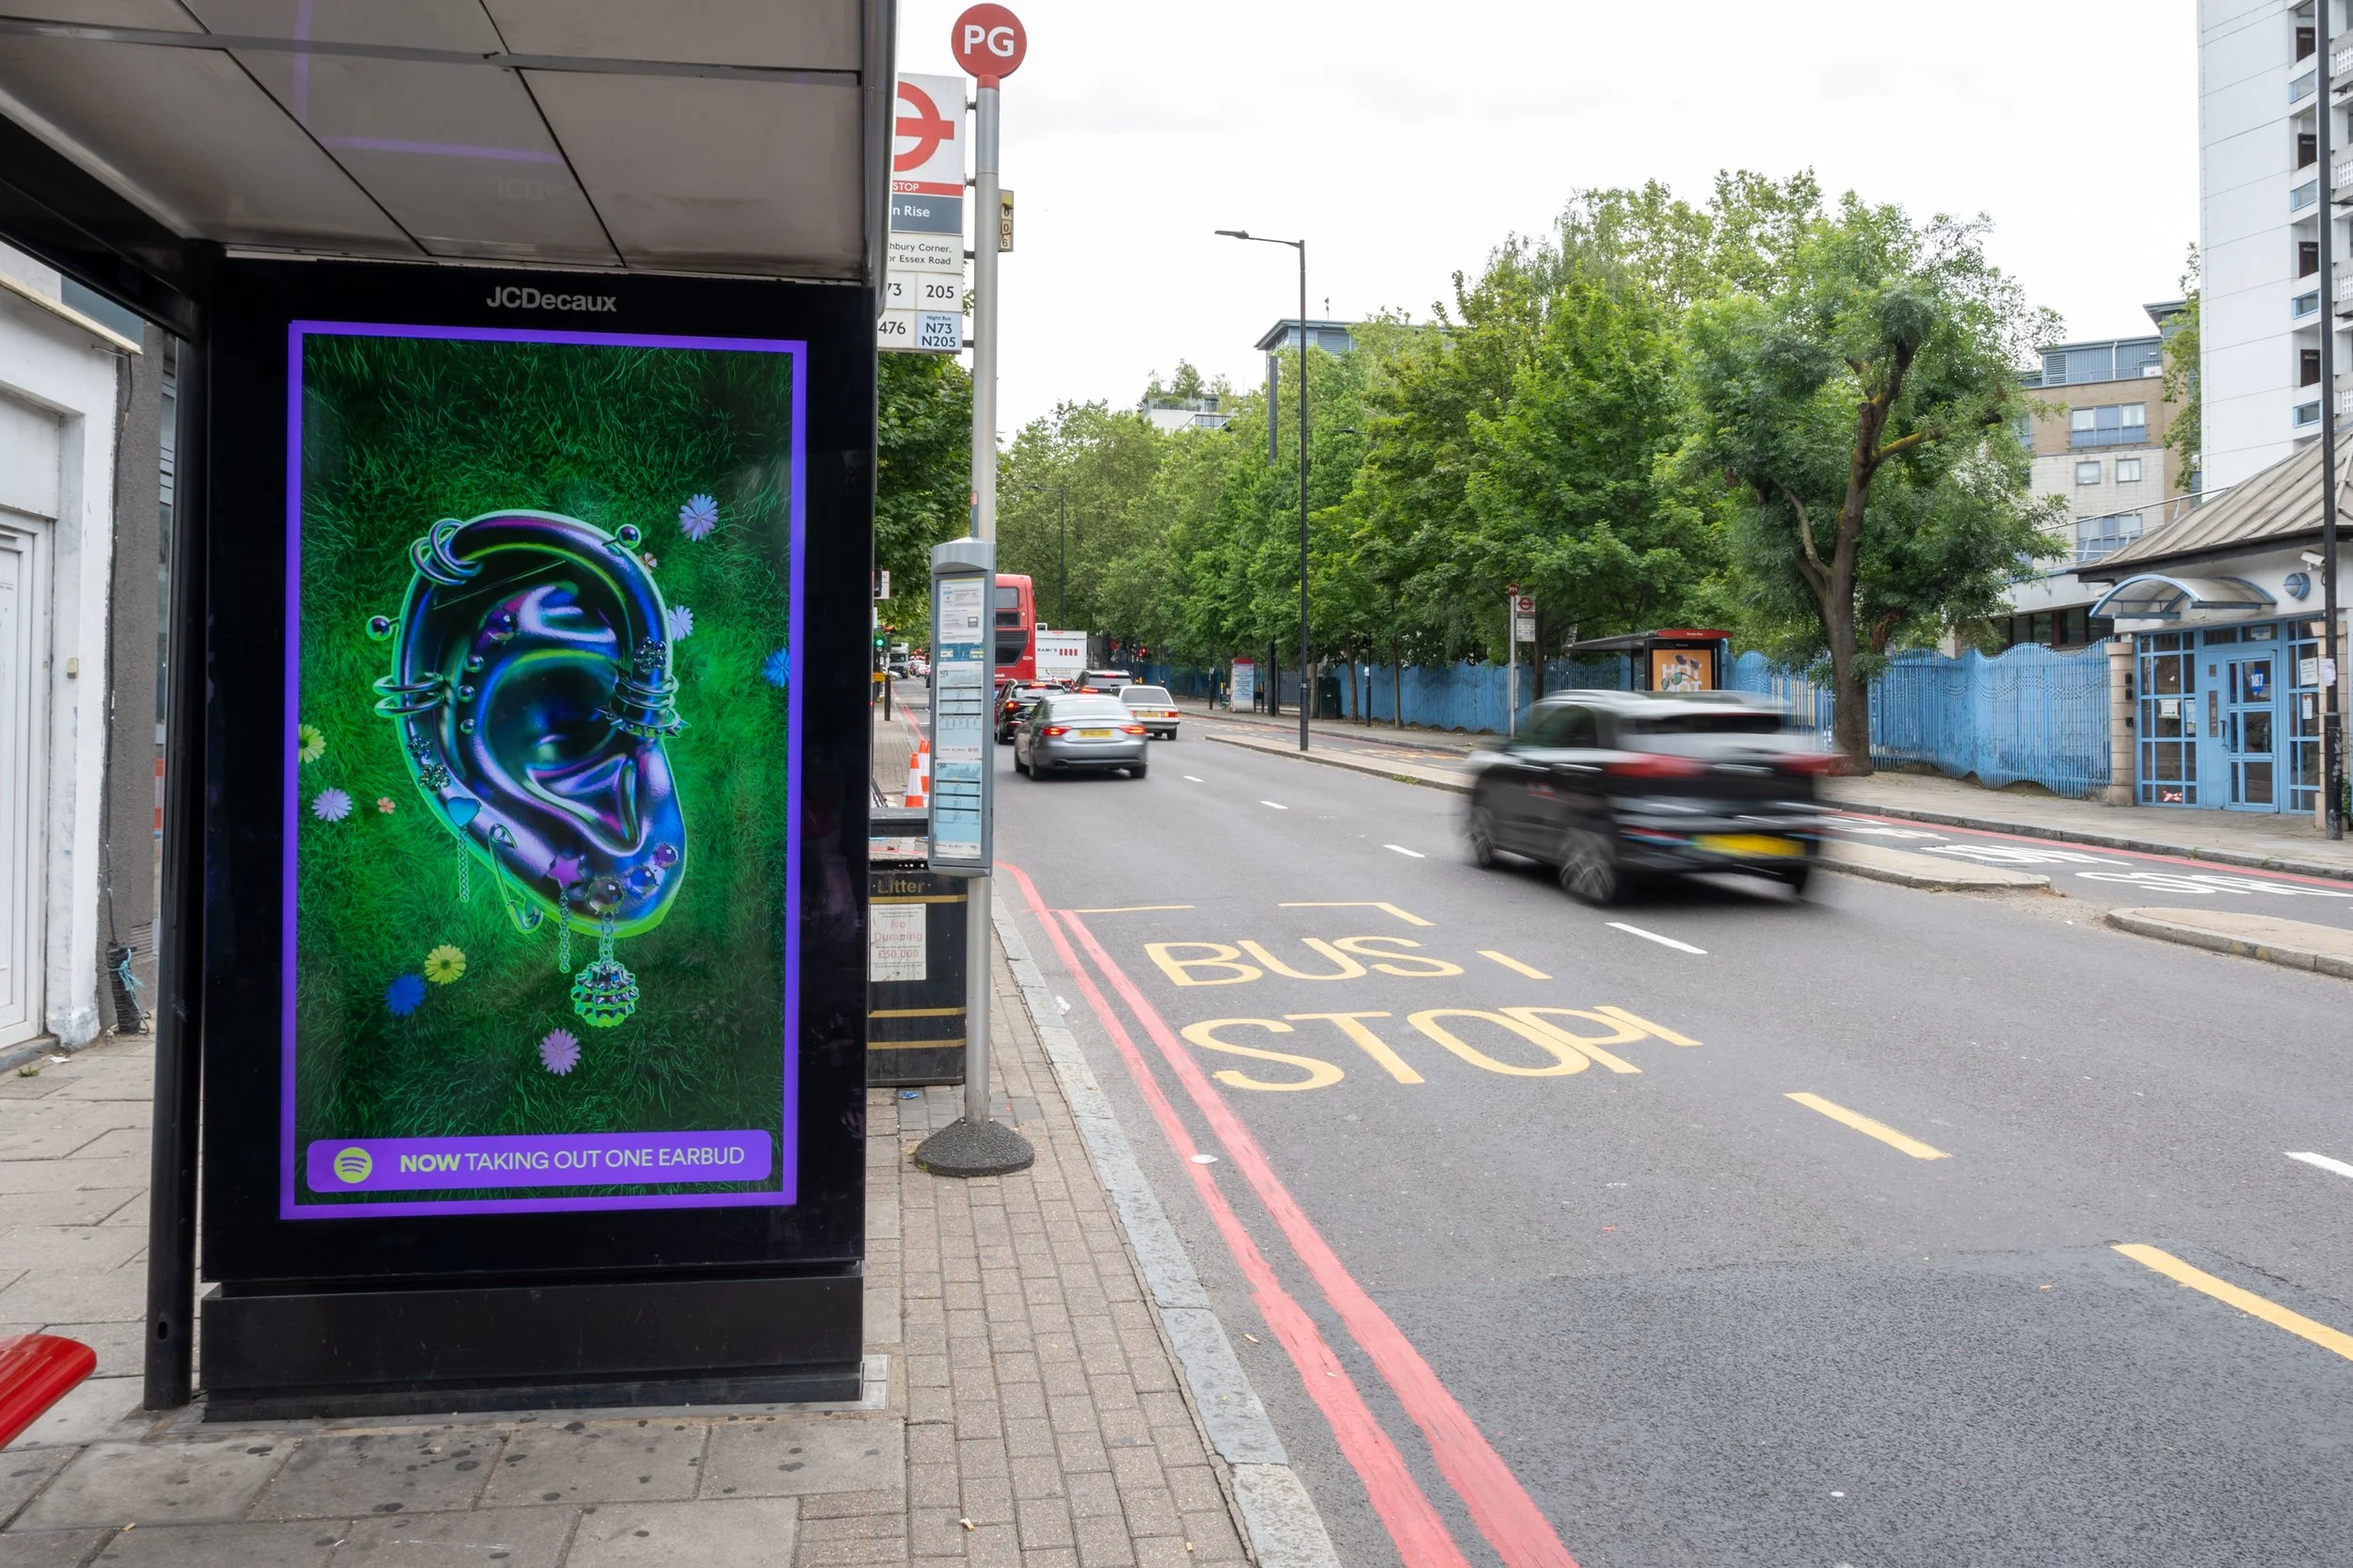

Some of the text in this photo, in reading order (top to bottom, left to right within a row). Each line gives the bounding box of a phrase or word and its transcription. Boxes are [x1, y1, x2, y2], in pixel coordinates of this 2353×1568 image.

[964, 24, 1015, 57] PG
[892, 182, 920, 192] STOP
[904, 205, 931, 217] Rise
[918, 244, 952, 254] Corner,
[899, 255, 925, 264] Essex
[928, 256, 952, 265] Road
[925, 284, 954, 299] 205
[486, 286, 617, 312] JCDecaux
[878, 321, 906, 335] 476
[926, 322, 952, 334] N73
[921, 336, 956, 347] N205
[2250, 673, 2264, 687] 187
[877, 879, 926, 894] Litter
[874, 932, 923, 942] Dumping
[1144, 936, 1465, 987] BUS
[1180, 1005, 1704, 1092] STOP
[400, 1146, 744, 1173] NOW TAKING OUT ONE EARBUD
